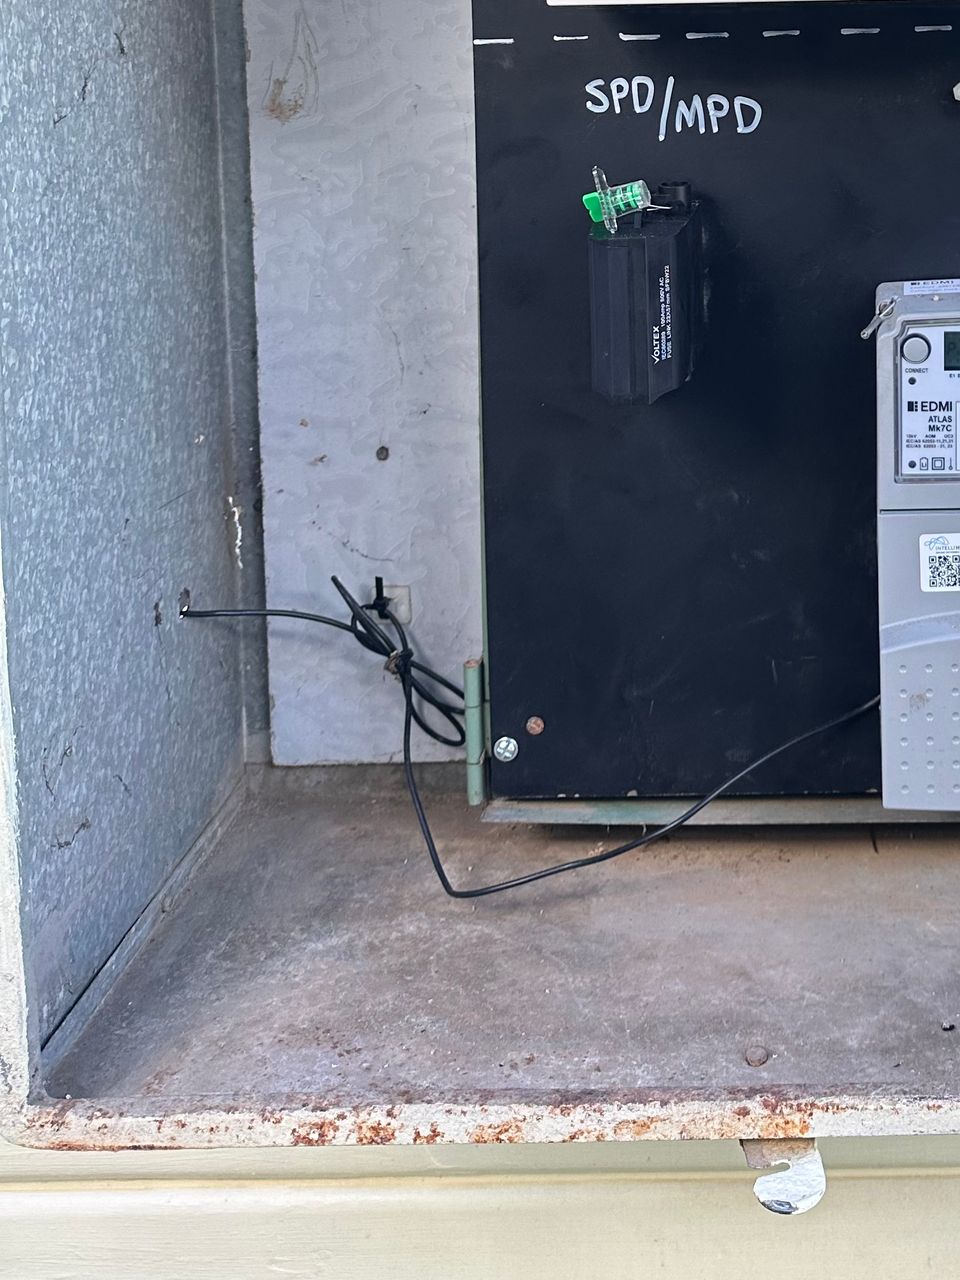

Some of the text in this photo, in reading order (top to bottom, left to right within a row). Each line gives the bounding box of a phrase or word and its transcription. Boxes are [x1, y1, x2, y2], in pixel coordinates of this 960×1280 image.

[584, 75, 763, 142] SPD/MPD
[658, 276, 664, 287] AC
[651, 325, 660, 365] VOLTEX
[920, 400, 953, 412] EDMI
[927, 415, 953, 423] ATLAS
[928, 424, 952, 432] Mk7C
